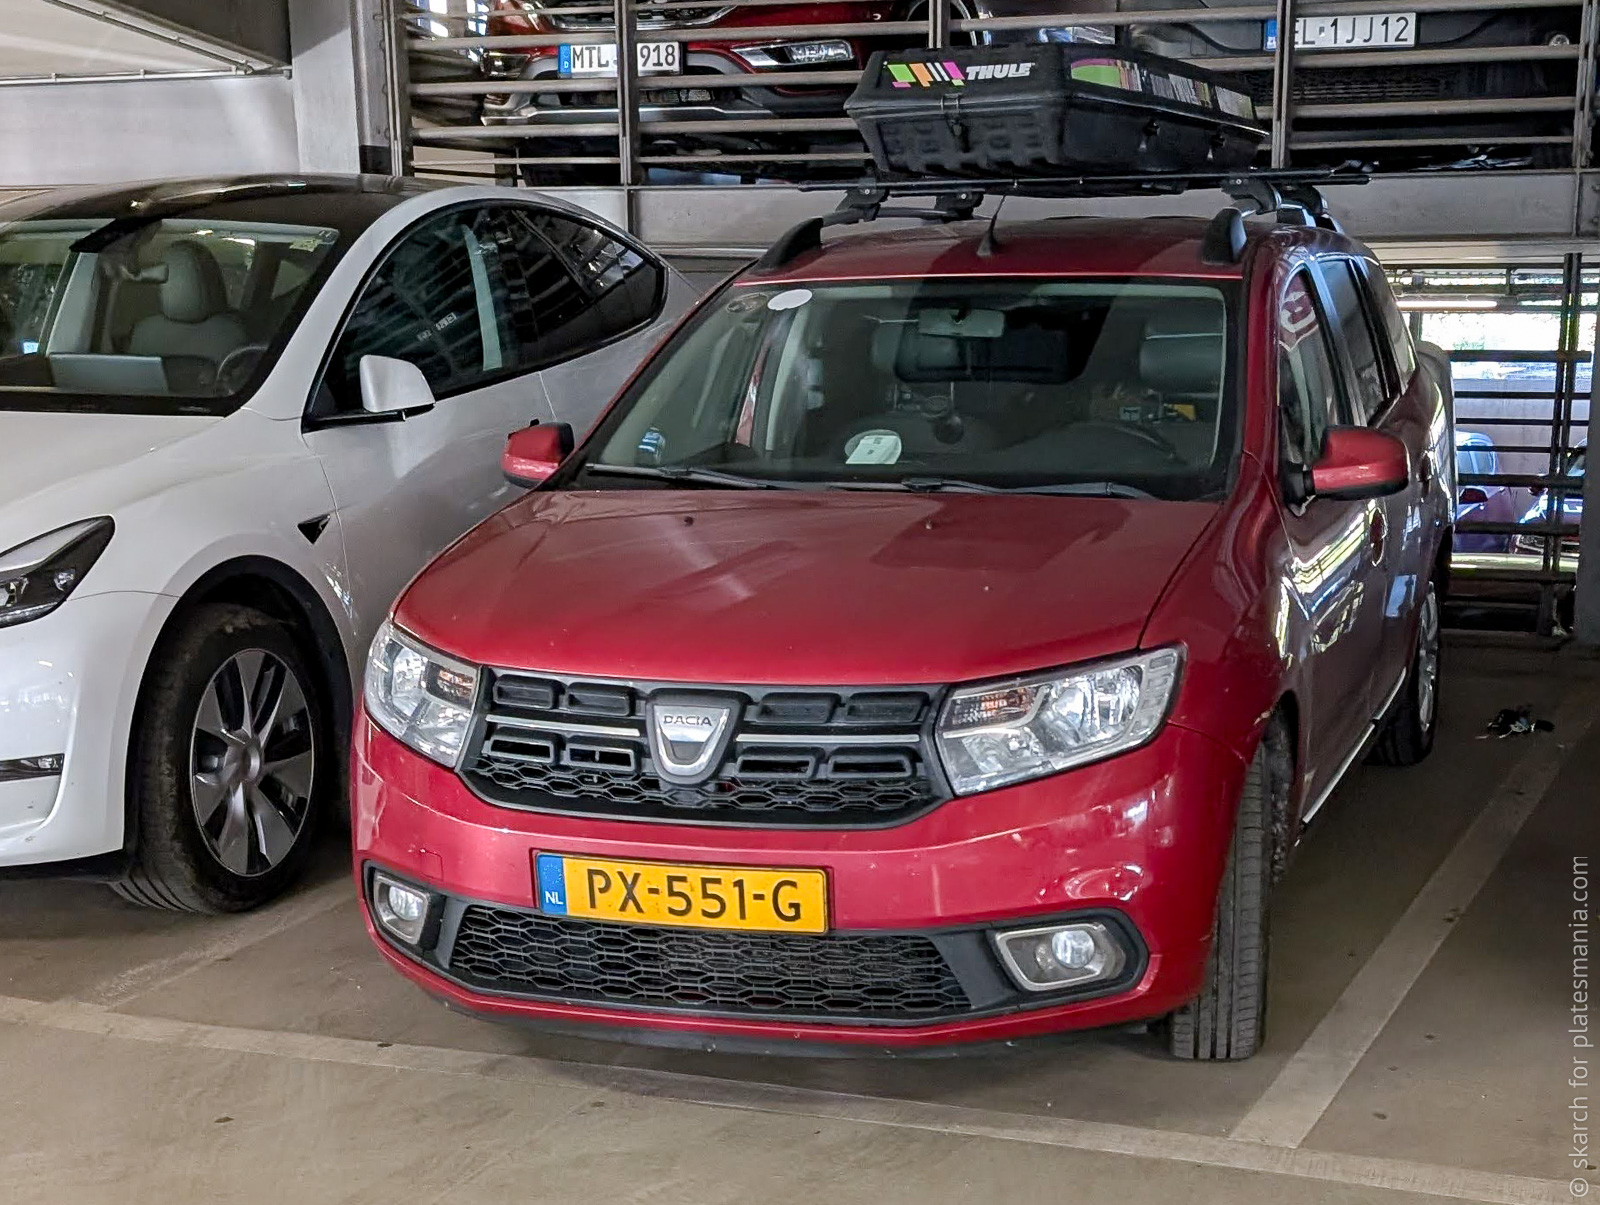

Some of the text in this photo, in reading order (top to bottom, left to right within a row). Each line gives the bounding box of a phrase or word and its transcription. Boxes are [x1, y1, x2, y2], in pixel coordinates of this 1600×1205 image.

[1330, 16, 1408, 44] 1JJ12
[563, 61, 569, 69] D
[572, 44, 676, 69] MTL 918
[965, 62, 1034, 81] THULE
[663, 715, 712, 727] DACIA
[545, 890, 564, 906] NL
[586, 868, 802, 922] PX-551-G
